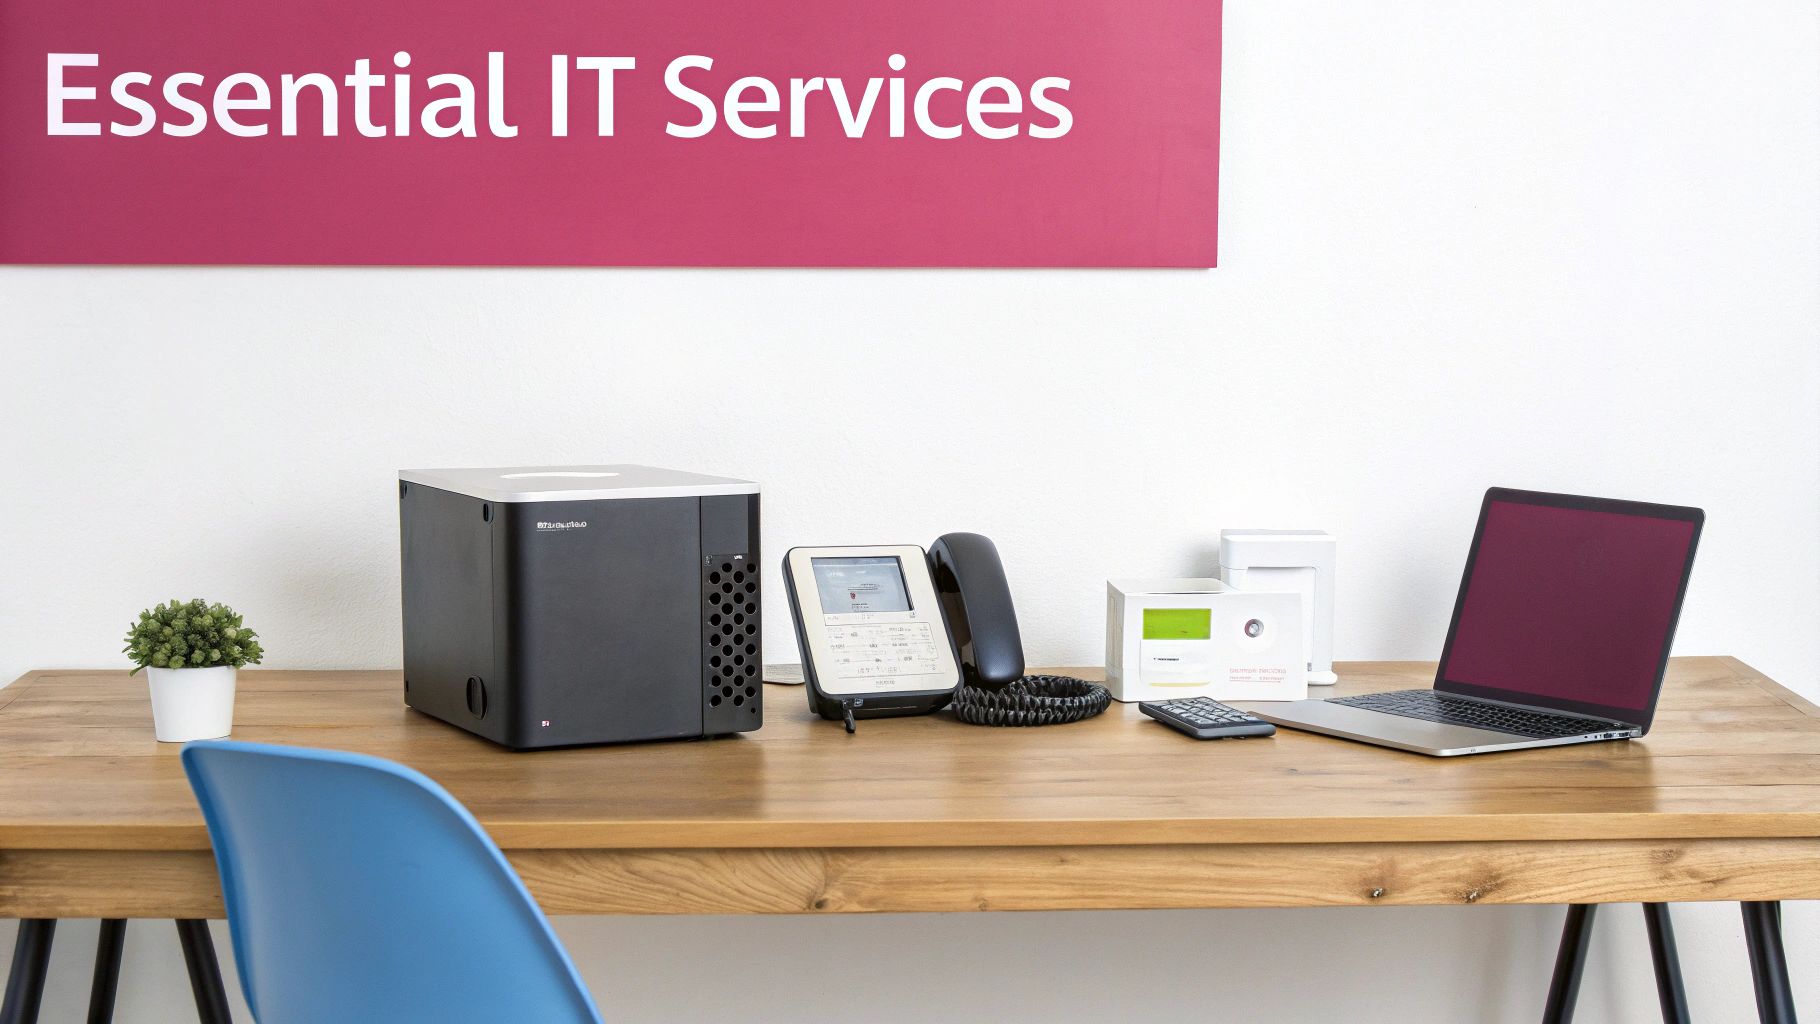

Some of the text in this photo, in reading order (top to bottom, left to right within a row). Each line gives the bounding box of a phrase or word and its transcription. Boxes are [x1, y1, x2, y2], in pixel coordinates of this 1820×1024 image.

[48, 51, 1073, 139] Essential IT Services
